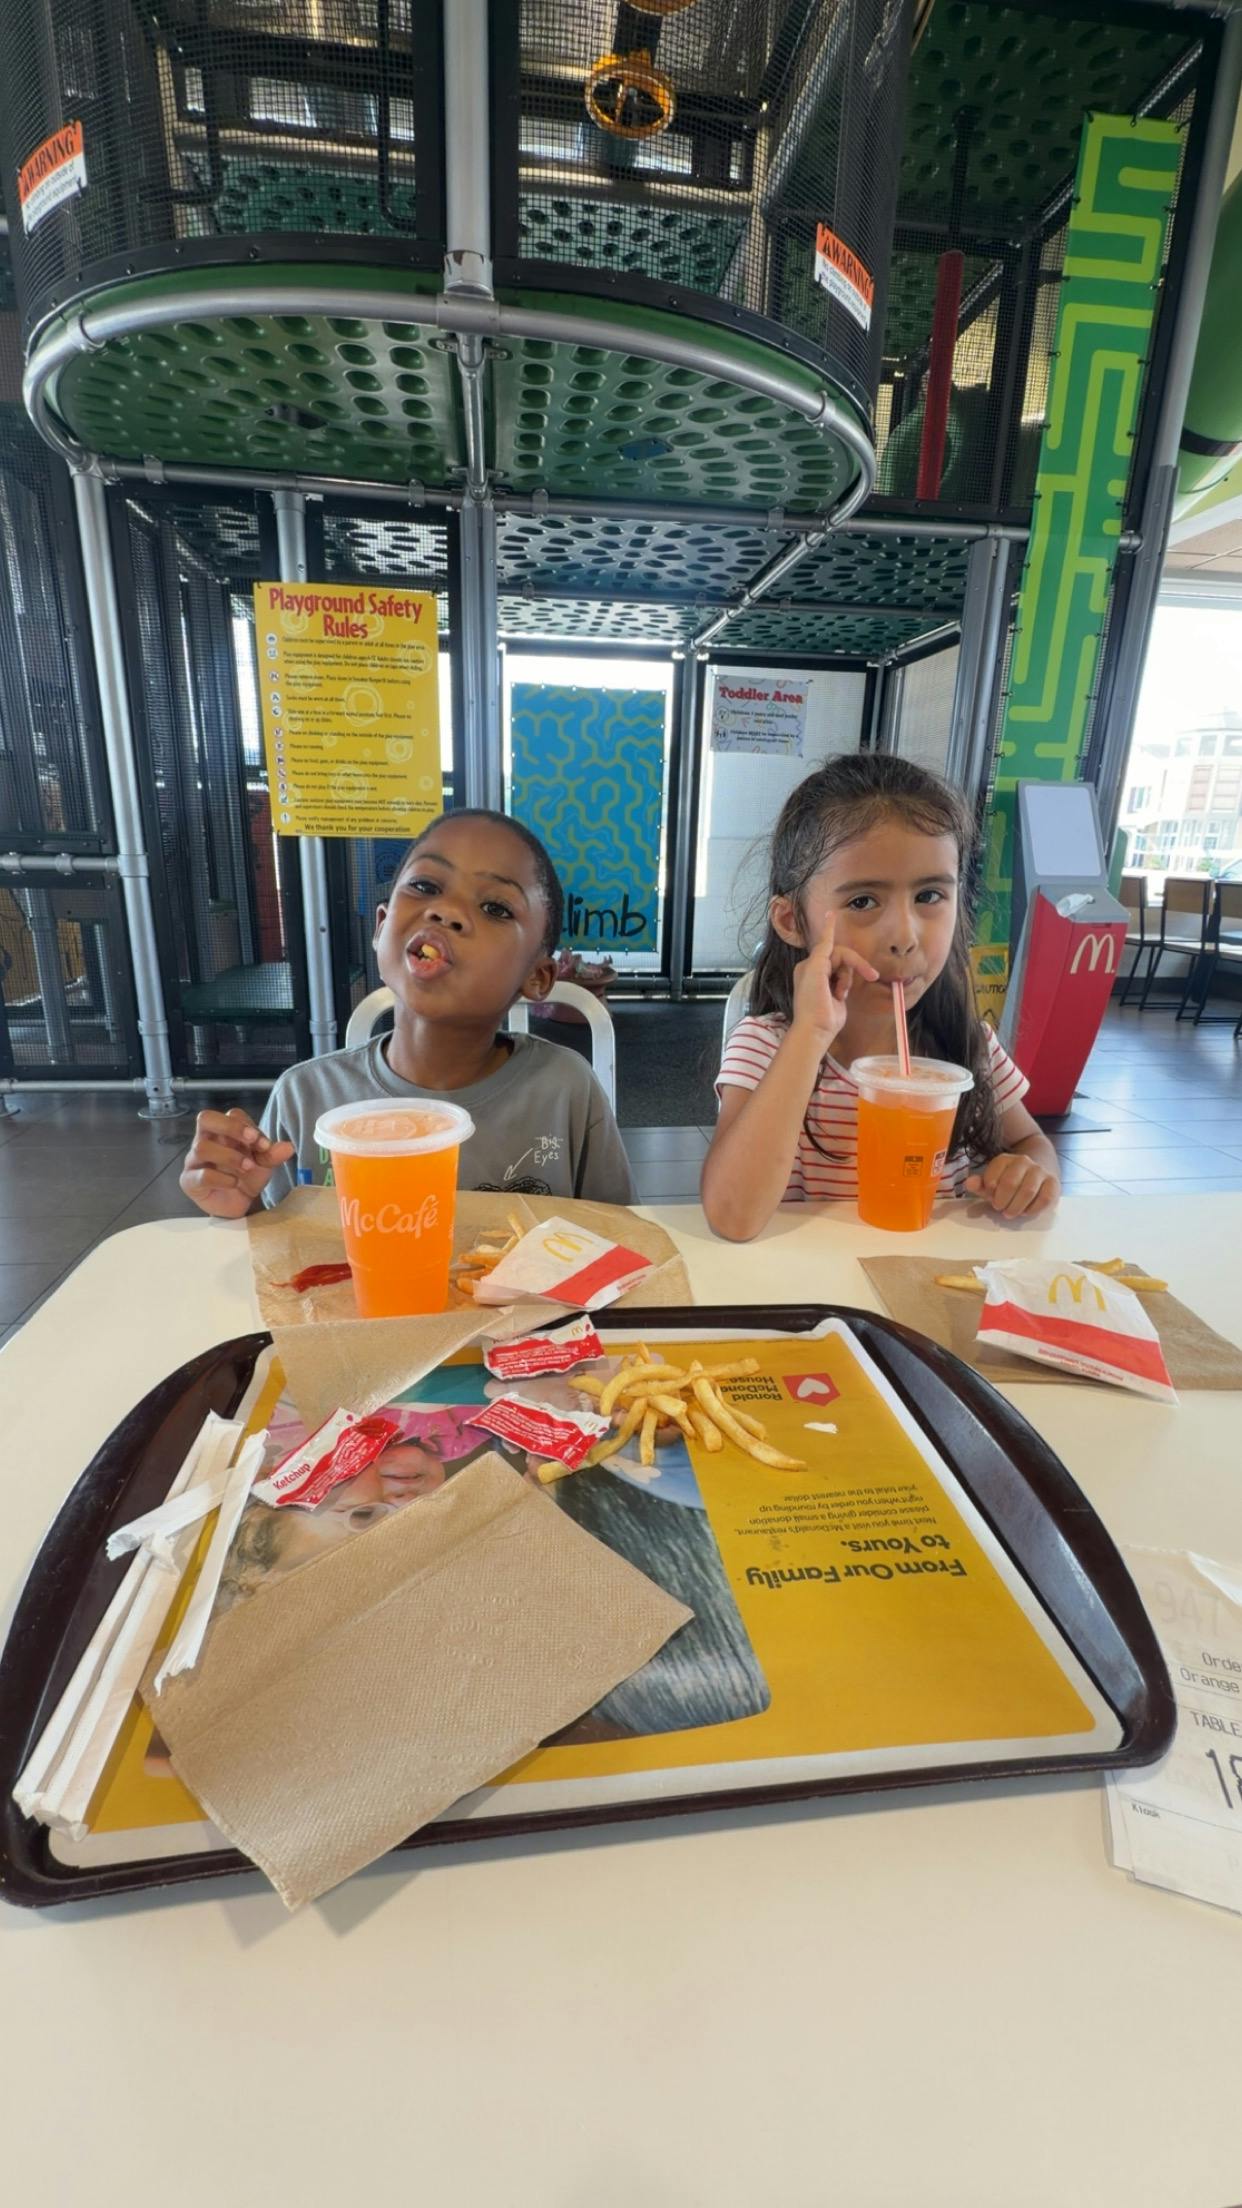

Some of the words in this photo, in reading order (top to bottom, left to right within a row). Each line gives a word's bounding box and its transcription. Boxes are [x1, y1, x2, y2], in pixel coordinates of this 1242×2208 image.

[28, 129, 75, 182] WARNING
[269, 587, 365, 617] Playground
[368, 592, 423, 624] Safety
[323, 613, 369, 639] Rules
[719, 685, 770, 701] Toddler
[772, 690, 804, 704] Area
[315, 823, 334, 831] thank
[336, 825, 347, 833] you
[358, 825, 373, 833] your
[374, 825, 411, 833] cooperation
[562, 892, 648, 938] limb
[540, 1134, 561, 1151] Big
[534, 1150, 560, 1168] Eyes
[340, 1194, 439, 1240] McCafé
[728, 1376, 775, 1384] House
[720, 1384, 779, 1393] McDona
[731, 1392, 784, 1402] Ronald
[272, 1463, 312, 1491] Ketchup
[810, 1489, 846, 1500] nearest
[847, 1488, 863, 1497] the
[863, 1487, 874, 1495] to
[874, 1486, 897, 1495] total
[856, 1497, 874, 1506] you
[874, 1496, 901, 1505] when
[901, 1493, 924, 1503] right
[758, 1504, 772, 1513] up
[772, 1503, 817, 1513] rounding
[817, 1501, 830, 1511] by
[830, 1500, 855, 1508] order
[899, 1504, 930, 1513] please
[793, 1513, 820, 1522] small
[827, 1510, 857, 1520] giving
[858, 1508, 898, 1517] consider
[748, 1515, 792, 1525] donation
[872, 1518, 890, 1529] you
[890, 1519, 914, 1527] time
[913, 1517, 937, 1525] Next
[787, 1524, 845, 1534] McDonald's
[853, 1521, 872, 1530] visit
[840, 1536, 923, 1555] Yours.
[920, 1534, 951, 1550] to
[843, 1563, 895, 1581] Our
[895, 1558, 968, 1577] From
[746, 1565, 842, 1590] Family
[1180, 1667, 1241, 1693] Orange
[1189, 1710, 1242, 1739] TABLE
